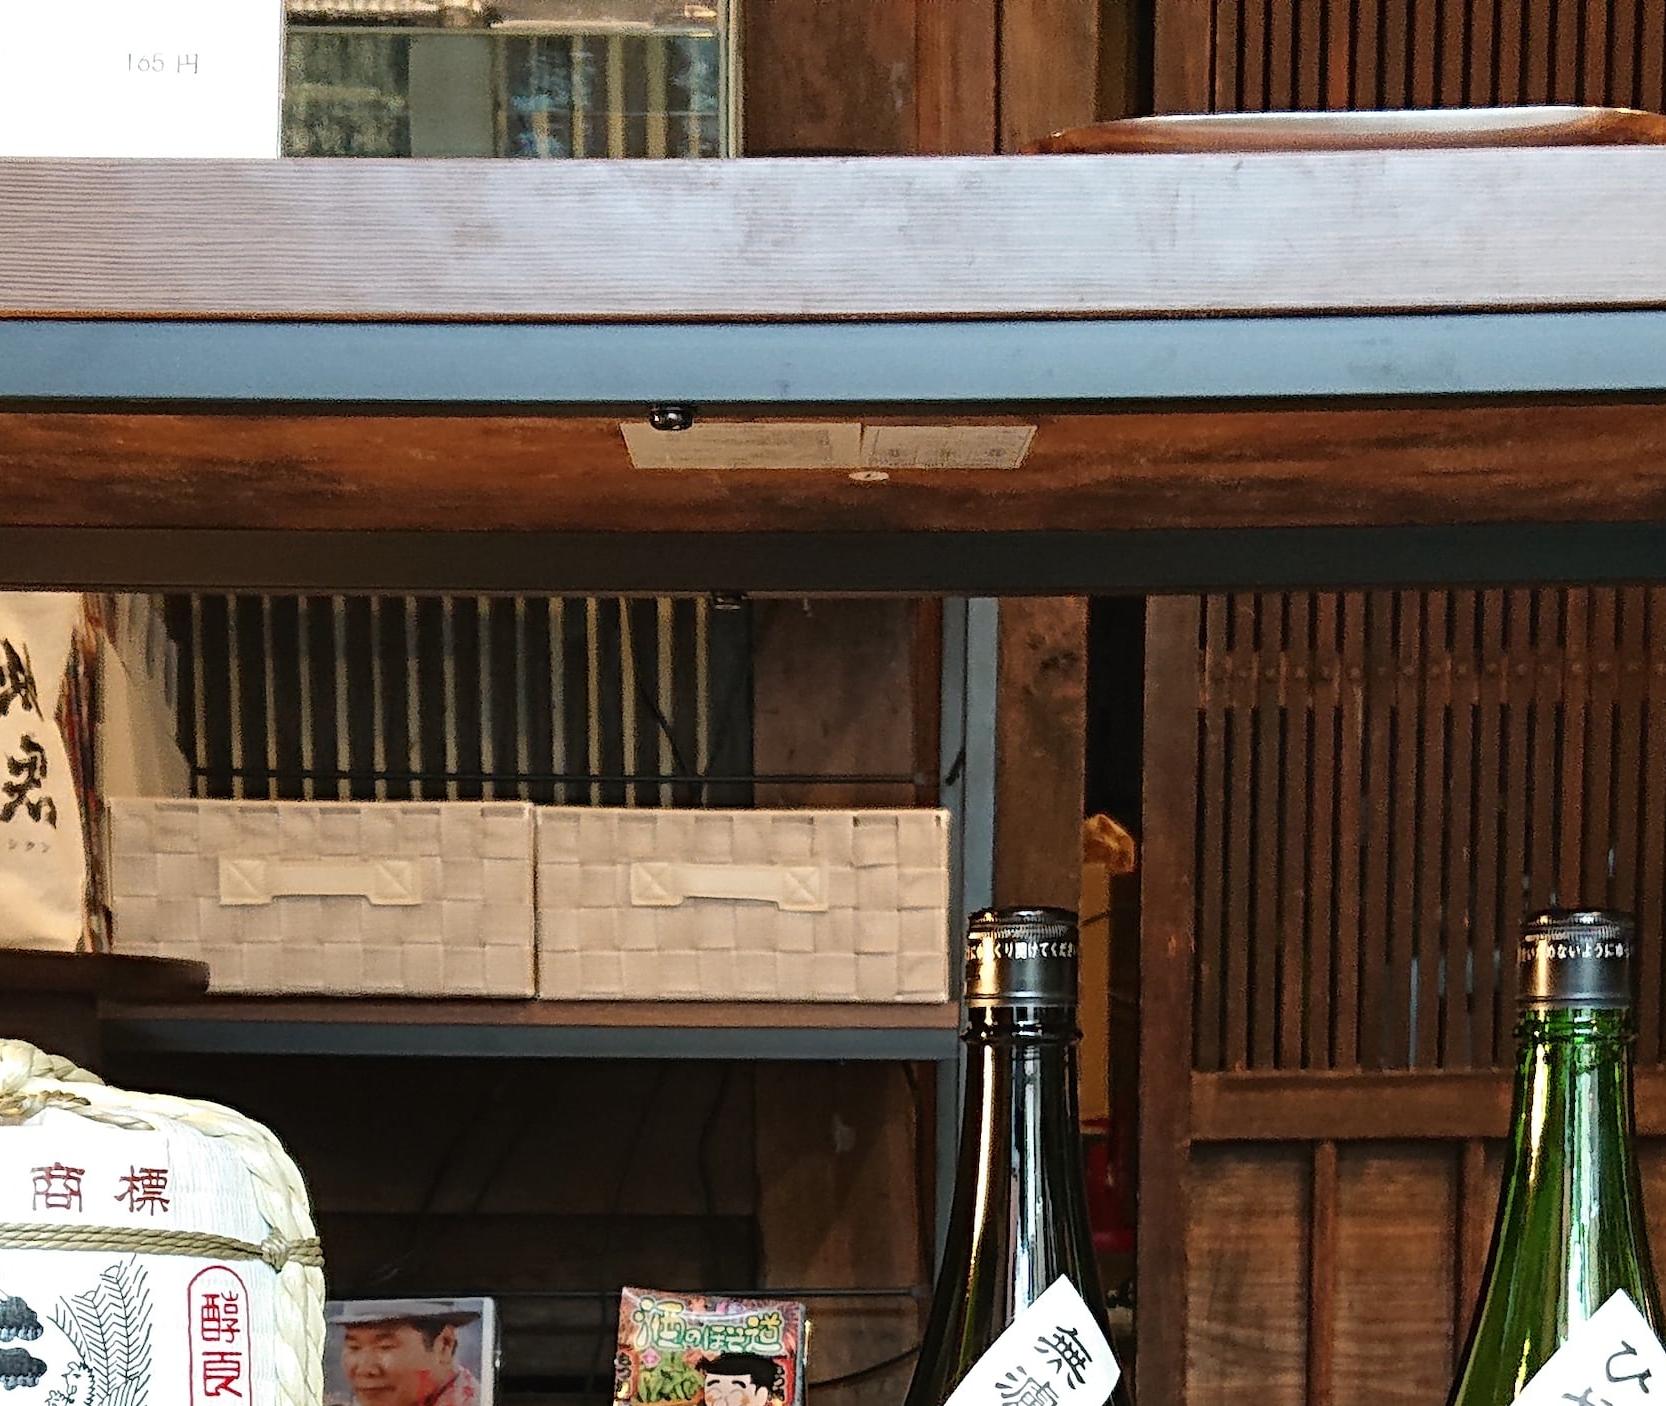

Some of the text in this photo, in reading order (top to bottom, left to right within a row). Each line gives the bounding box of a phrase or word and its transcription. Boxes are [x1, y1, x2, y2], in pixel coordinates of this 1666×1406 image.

[30, 1160, 171, 1217] 商標
[634, 1297, 783, 1352] 酒のほそ道
